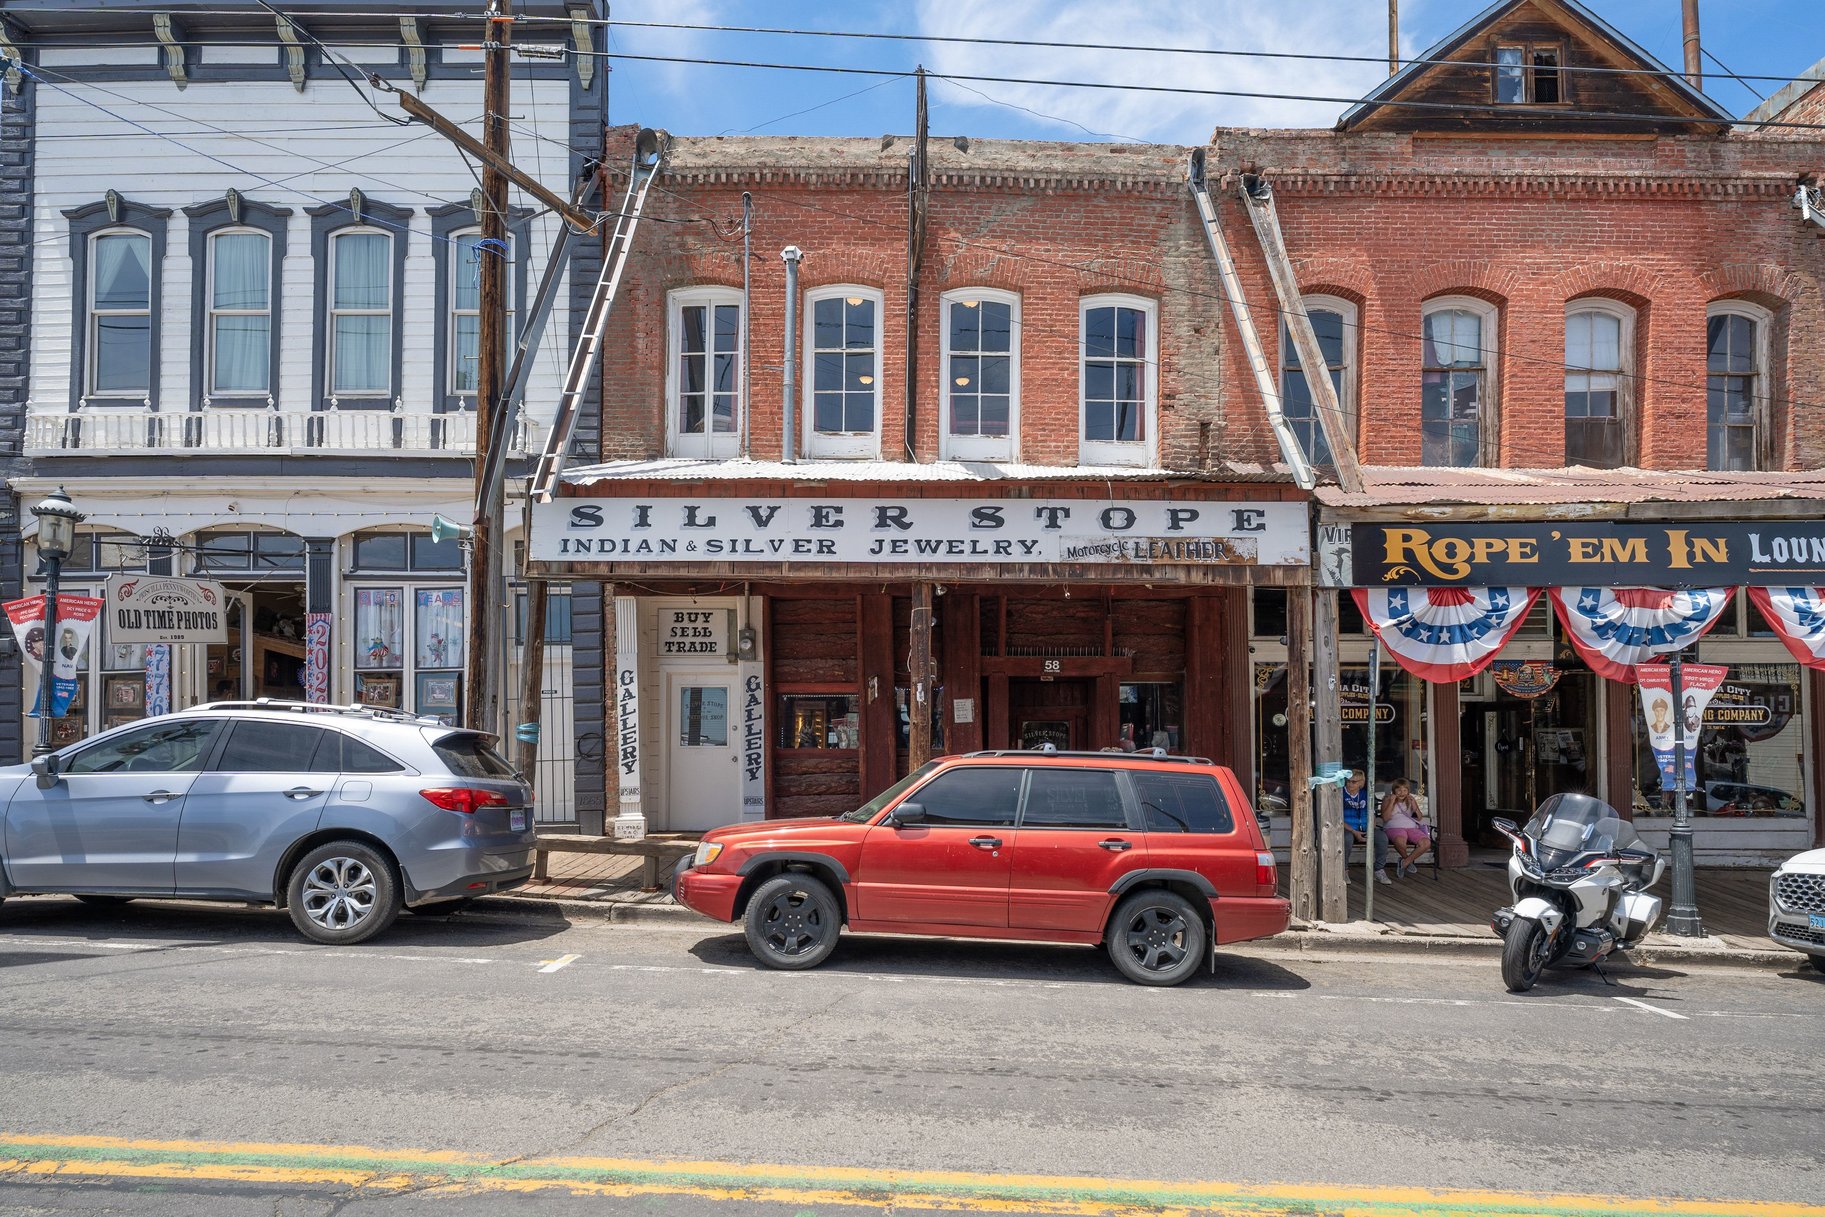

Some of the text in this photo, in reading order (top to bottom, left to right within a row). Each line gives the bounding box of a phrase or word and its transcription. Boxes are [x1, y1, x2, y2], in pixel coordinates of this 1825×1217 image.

[569, 505, 1267, 532] SILVER STOPE
[561, 538, 1043, 556] INDIAN & SILVER JEWELRY,
[1381, 528, 1539, 580] ROPE
[1663, 529, 1729, 569] IN
[59, 597, 83, 605] AMERICAN
[418, 591, 462, 604] YEARS
[118, 608, 218, 630] OLD TIME PHOTOS
[674, 612, 713, 623] BUY
[670, 627, 713, 637] SELL
[664, 641, 717, 653] TRADE
[1044, 660, 1060, 670] 58
[1727, 685, 1752, 696] CITY
[1342, 708, 1389, 719] COMPNY
[1717, 708, 1764, 721] COMPANY
[620, 669, 638, 775] GALLERY
[744, 675, 762, 782] GALLERY
[743, 797, 764, 806] UPSTAIRS
